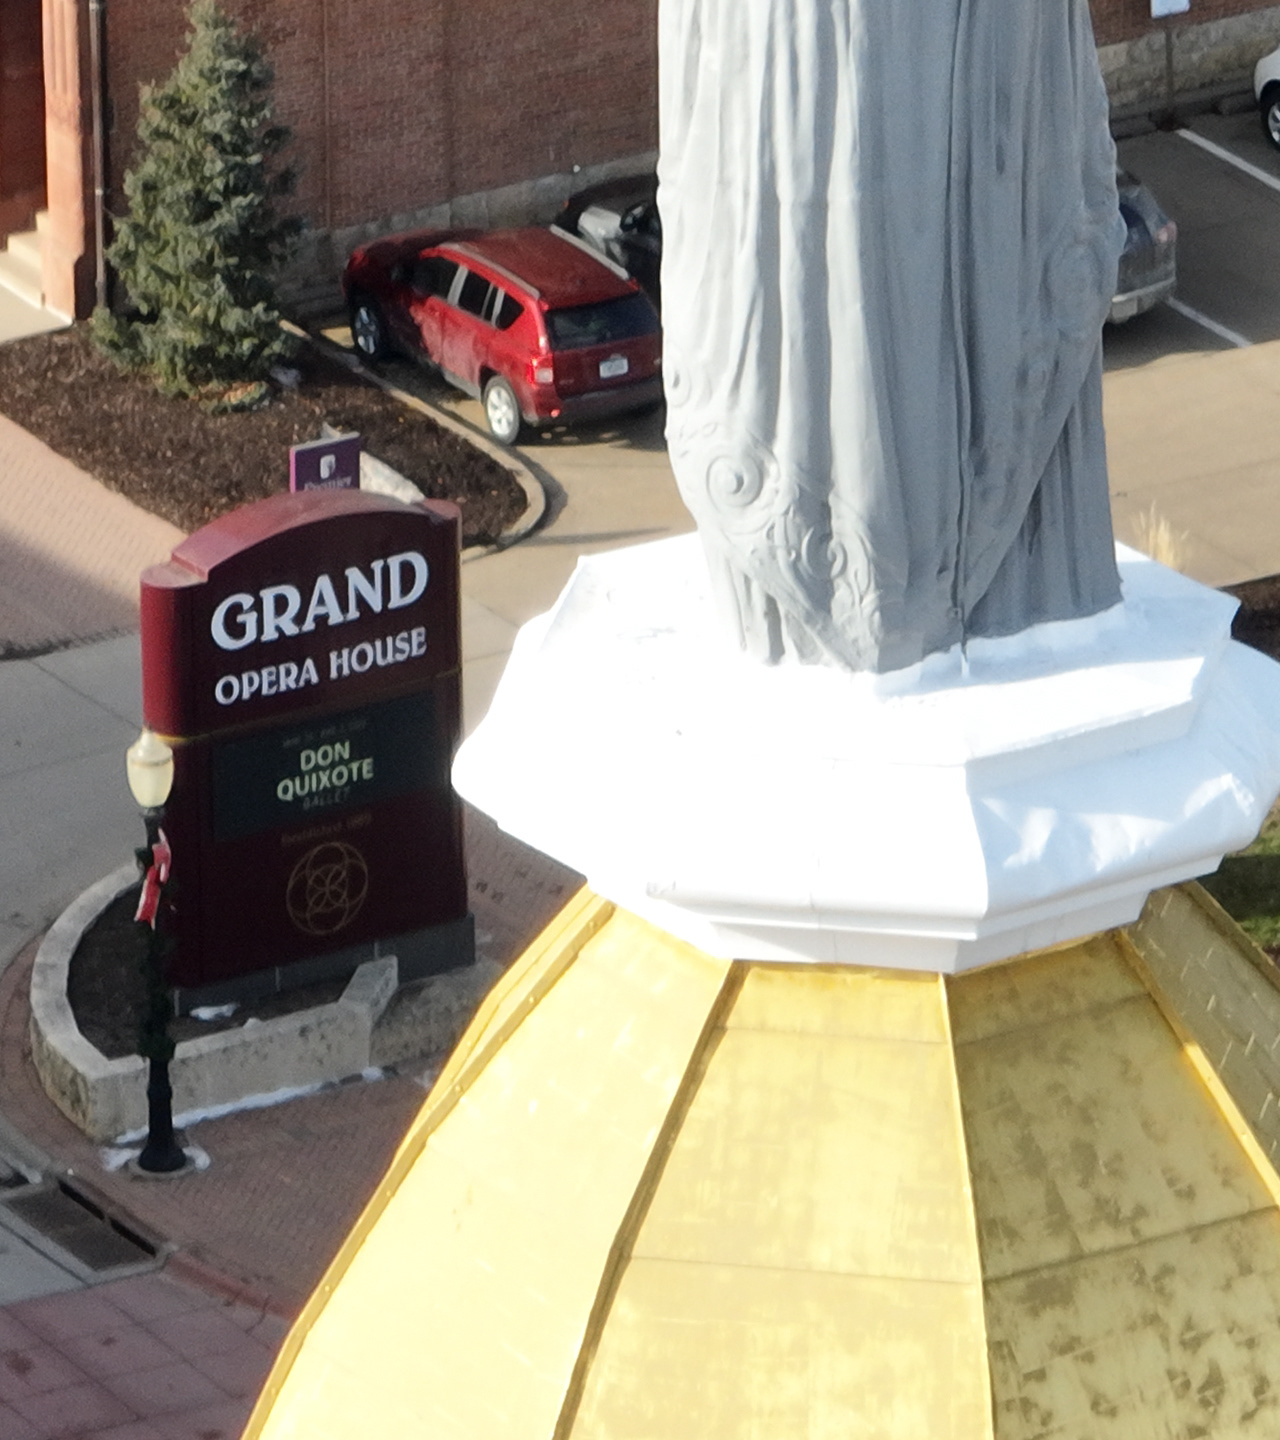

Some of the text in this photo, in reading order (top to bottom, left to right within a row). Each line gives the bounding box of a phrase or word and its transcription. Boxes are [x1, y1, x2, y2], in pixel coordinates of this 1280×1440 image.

[210, 551, 430, 652] GRAND
[214, 626, 428, 706] OPERA HOUSE
[276, 756, 375, 802] QUIXOTE
[299, 739, 351, 773] DON
